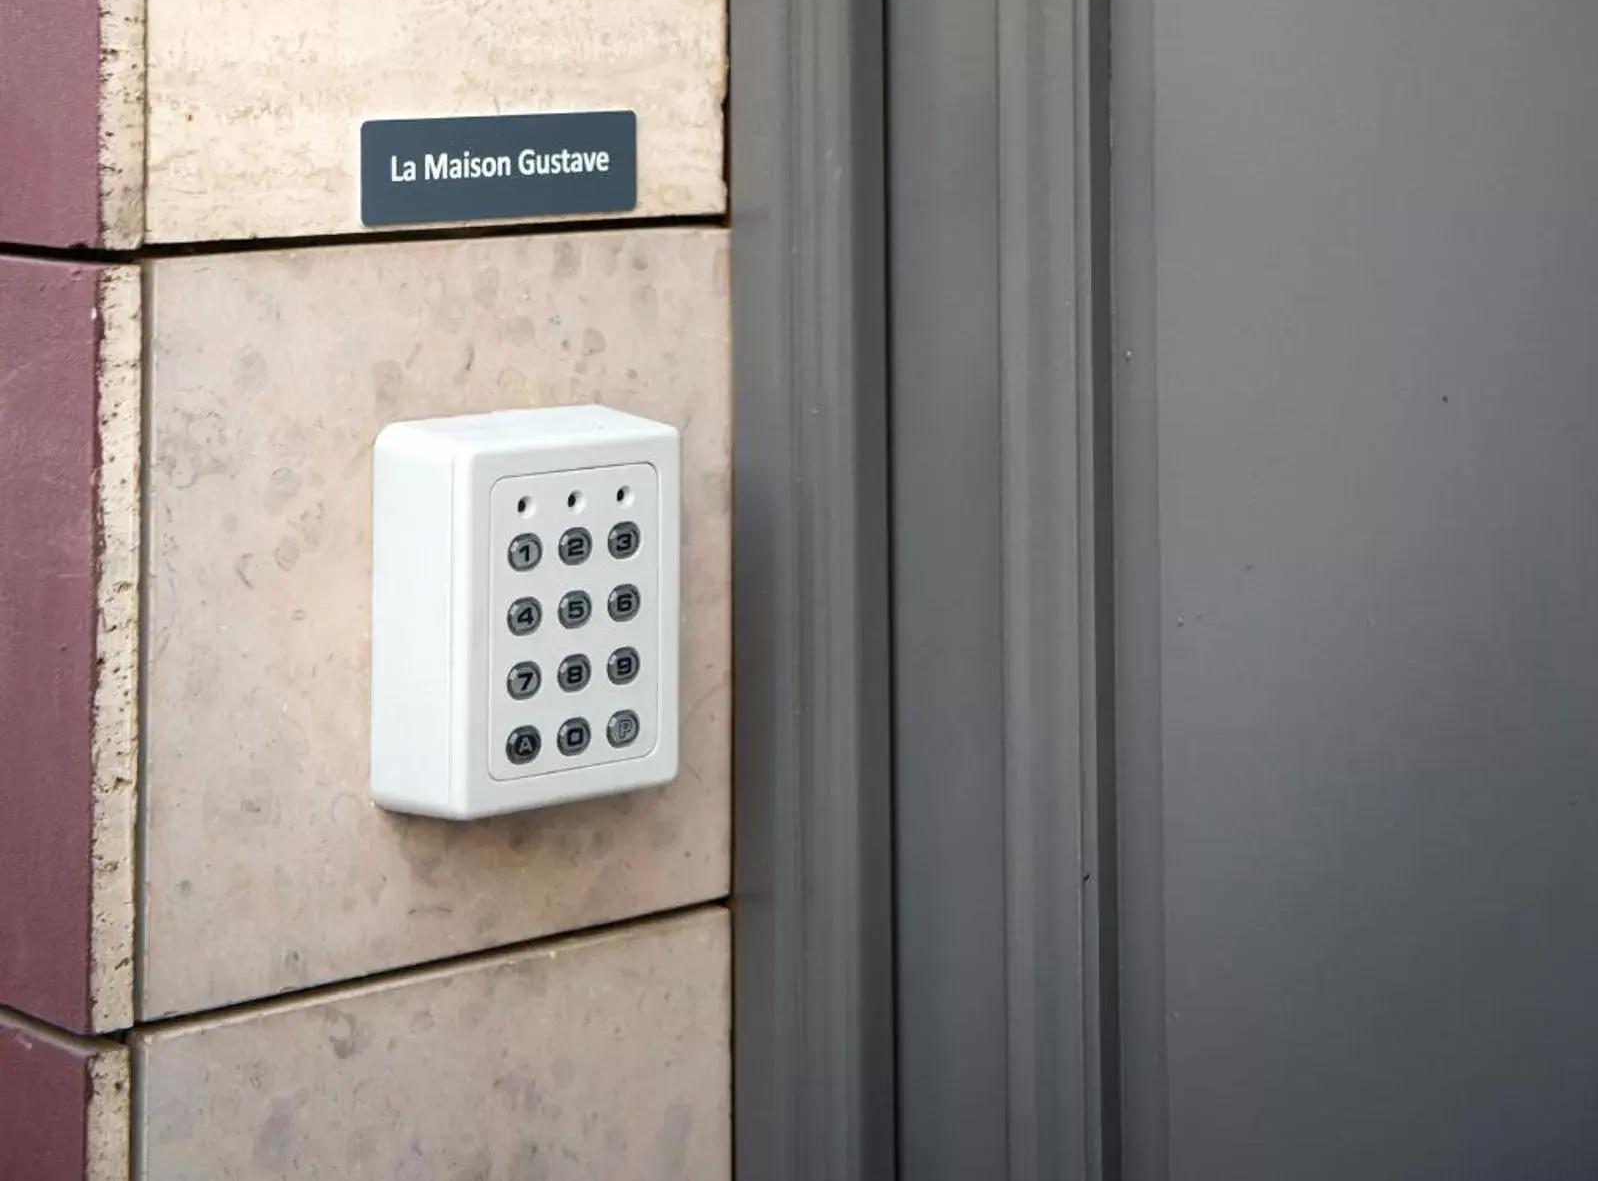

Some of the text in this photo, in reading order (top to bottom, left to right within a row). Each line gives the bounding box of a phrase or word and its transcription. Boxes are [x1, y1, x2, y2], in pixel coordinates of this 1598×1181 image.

[391, 149, 610, 182] La Maison Gustave
[518, 533, 632, 562] 1 2 3
[517, 593, 632, 626] 4 5 6
[517, 656, 632, 690] 7 8 9
[517, 735, 533, 754] A
[618, 719, 632, 739] P
